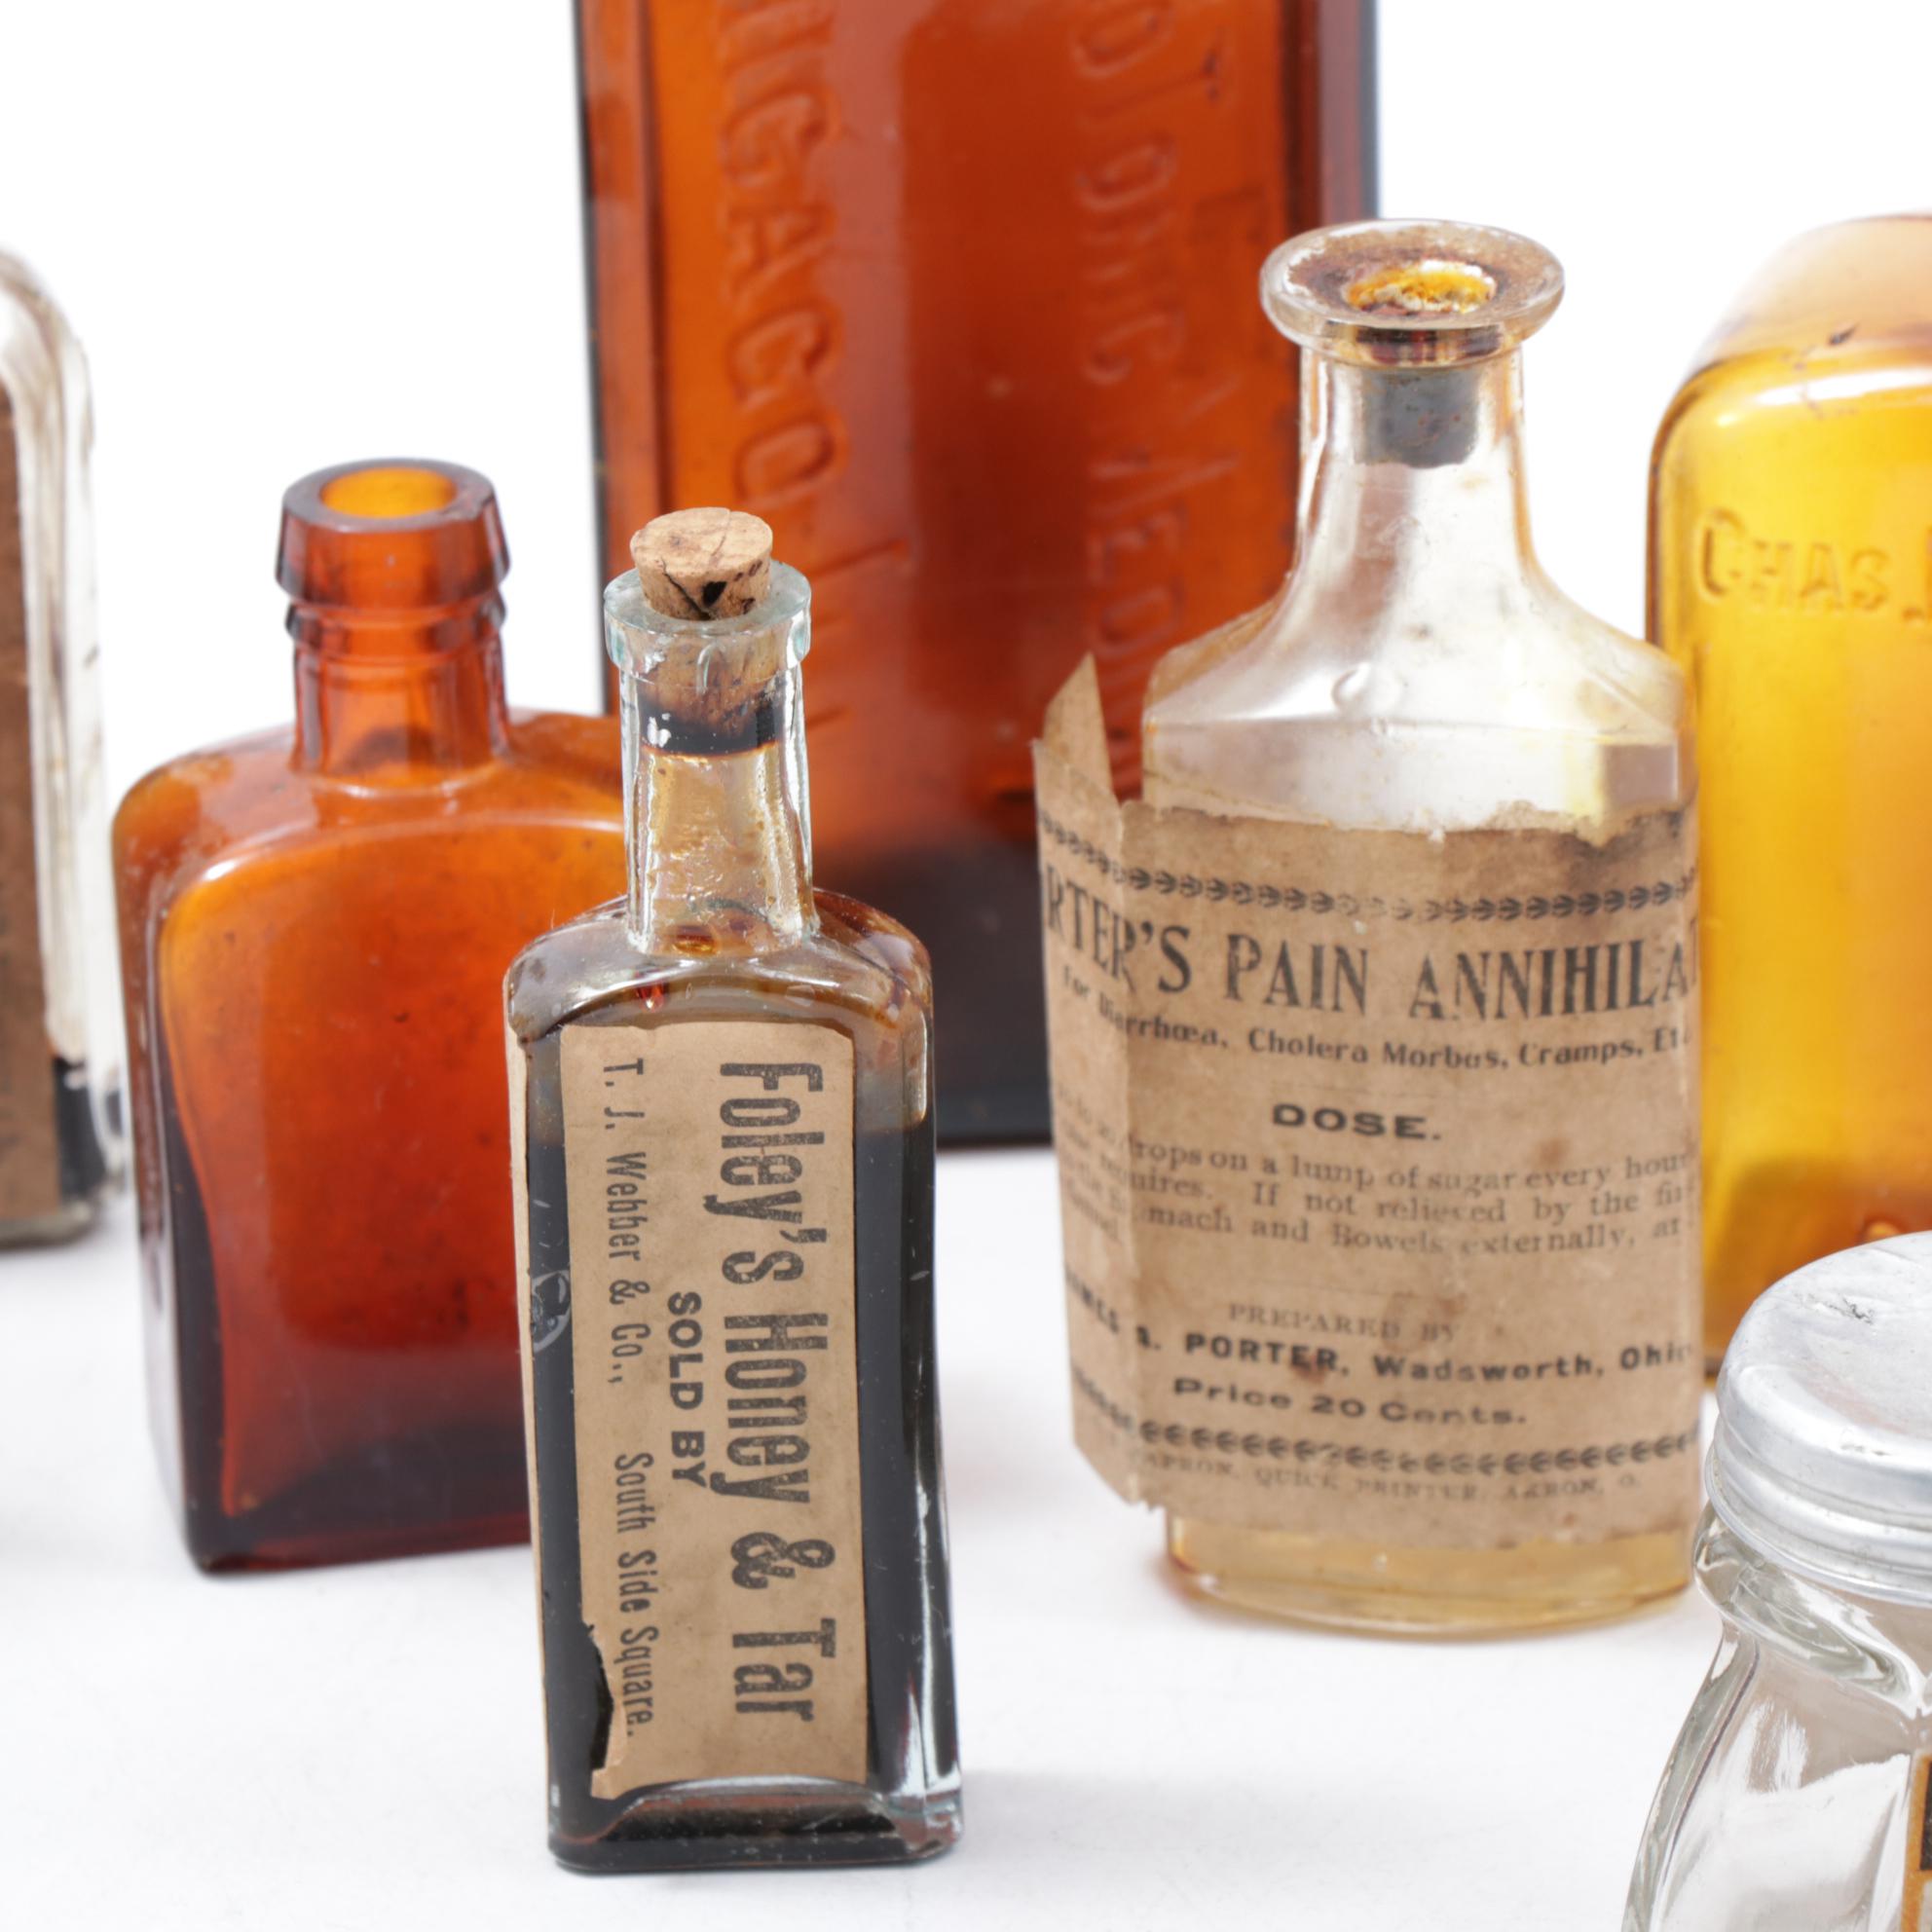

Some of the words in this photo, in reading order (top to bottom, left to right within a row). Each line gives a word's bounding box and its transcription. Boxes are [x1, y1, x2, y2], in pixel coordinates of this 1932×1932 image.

[1223, 932, 1368, 1019] PAIN
[603, 1058, 644, 1087] T.
[1247, 1025, 1369, 1064] Cholera
[1382, 1040, 1508, 1070] Morbus,
[1518, 1038, 1644, 1069] Cramps,
[604, 1105, 646, 1130] J.
[1272, 1102, 1442, 1141] DOSE.
[702, 1061, 828, 1285] Foley's
[1209, 1148, 1247, 1171] on
[1261, 1156, 1278, 1176] a
[1292, 1154, 1375, 1192] lump
[1388, 1165, 1420, 1190] of
[1428, 1170, 1515, 1199] sugar
[1525, 1167, 1612, 1197] every
[606, 1150, 648, 1262] Webber
[1253, 1181, 1279, 1207] If
[1305, 1193, 1357, 1215] not
[1533, 1196, 1572, 1226] by
[1590, 1190, 1640, 1216] the
[1251, 1219, 1310, 1244] and
[1332, 1222, 1444, 1255] Bowels
[1461, 1223, 1636, 1255] externally,
[609, 1279, 651, 1306] &
[1229, 1303, 1400, 1339] PREPARED
[1420, 1320, 1459, 1343] BY
[667, 1290, 705, 1411] SOLD
[1185, 1331, 1350, 1375] PORTER,
[1372, 1354, 1605, 1382] Wadsworth,
[710, 1312, 829, 1505] Honey
[1173, 1376, 1292, 1409] Price
[1311, 1393, 1365, 1418] 20
[670, 1430, 707, 1488] BY
[613, 1451, 656, 1535] South
[616, 1548, 659, 1615] Side
[730, 1531, 836, 1590] &
[613, 1624, 659, 1738] Square.
[731, 1617, 836, 1723] Tar
